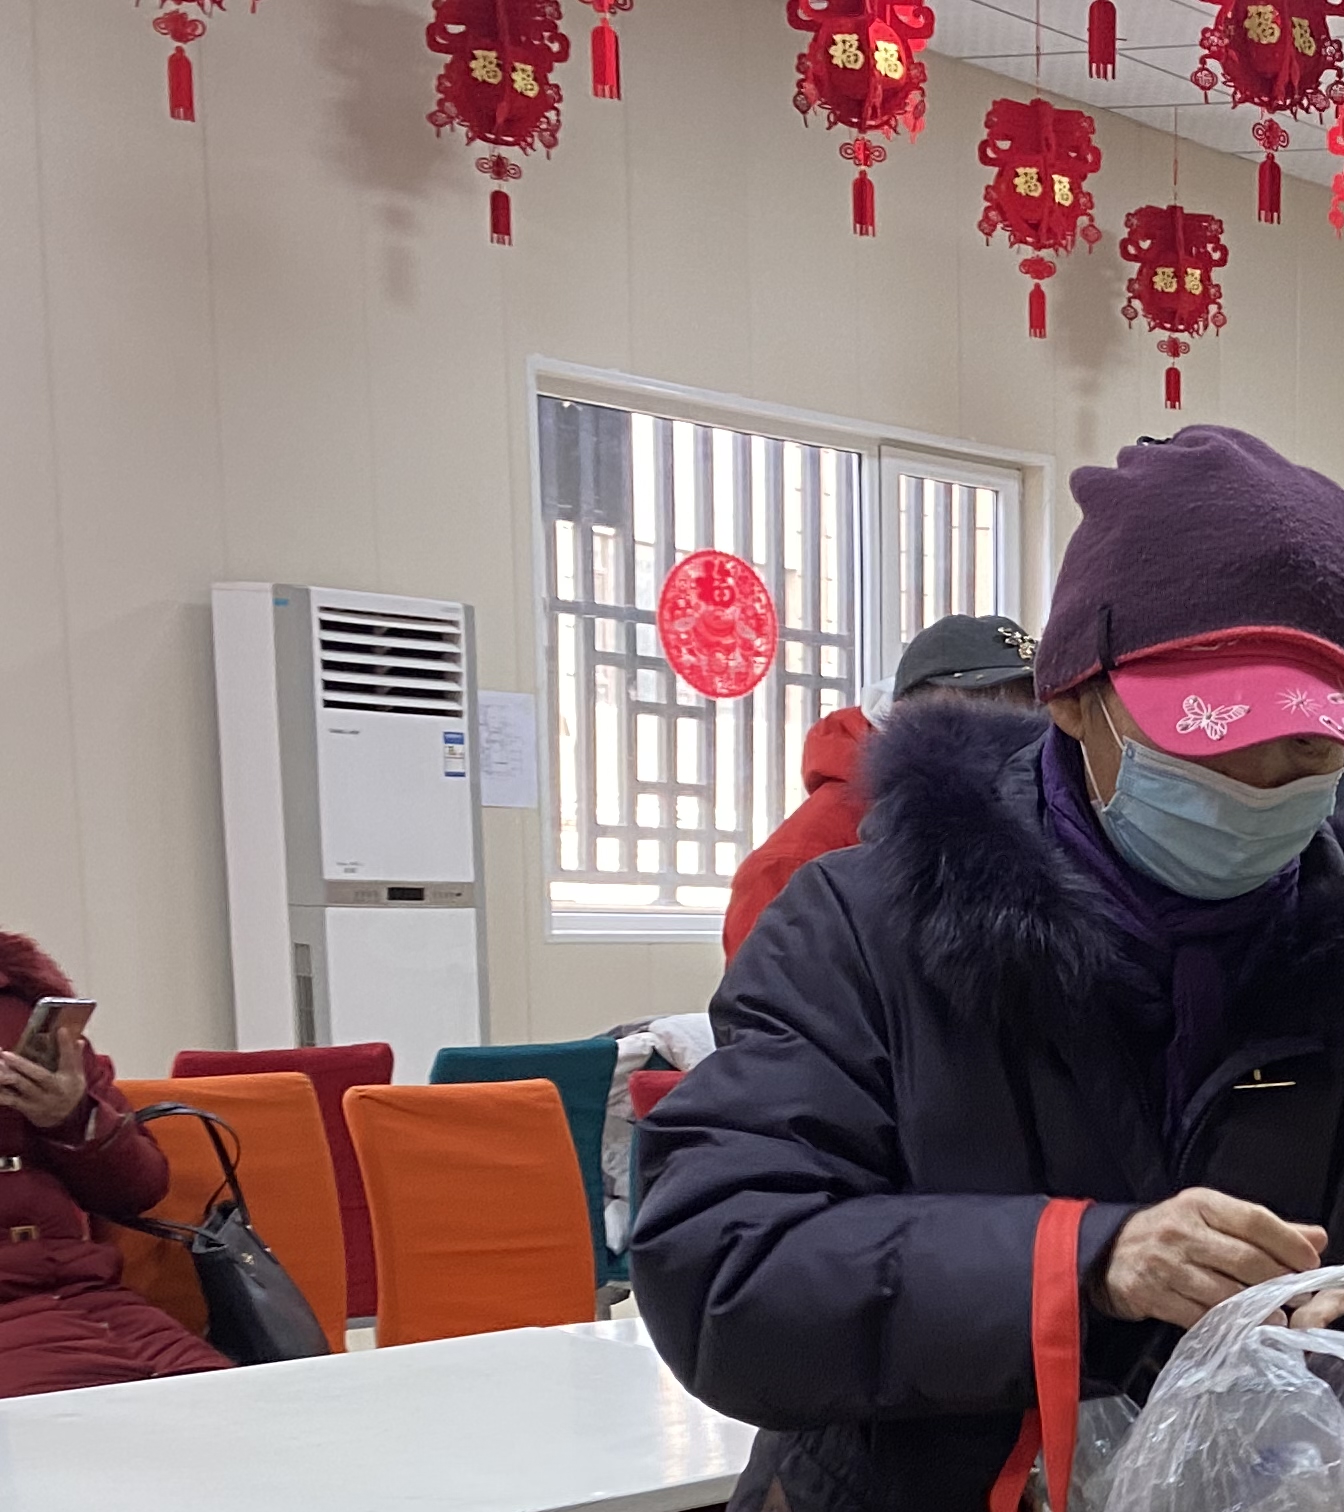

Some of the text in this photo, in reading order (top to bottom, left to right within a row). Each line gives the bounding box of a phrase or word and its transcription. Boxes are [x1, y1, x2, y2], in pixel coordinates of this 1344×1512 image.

[1245, 5, 1280, 44] 福
[469, 50, 501, 84] 福
[829, 34, 864, 69] 福
[874, 40, 903, 79] 福
[511, 62, 539, 97] 福
